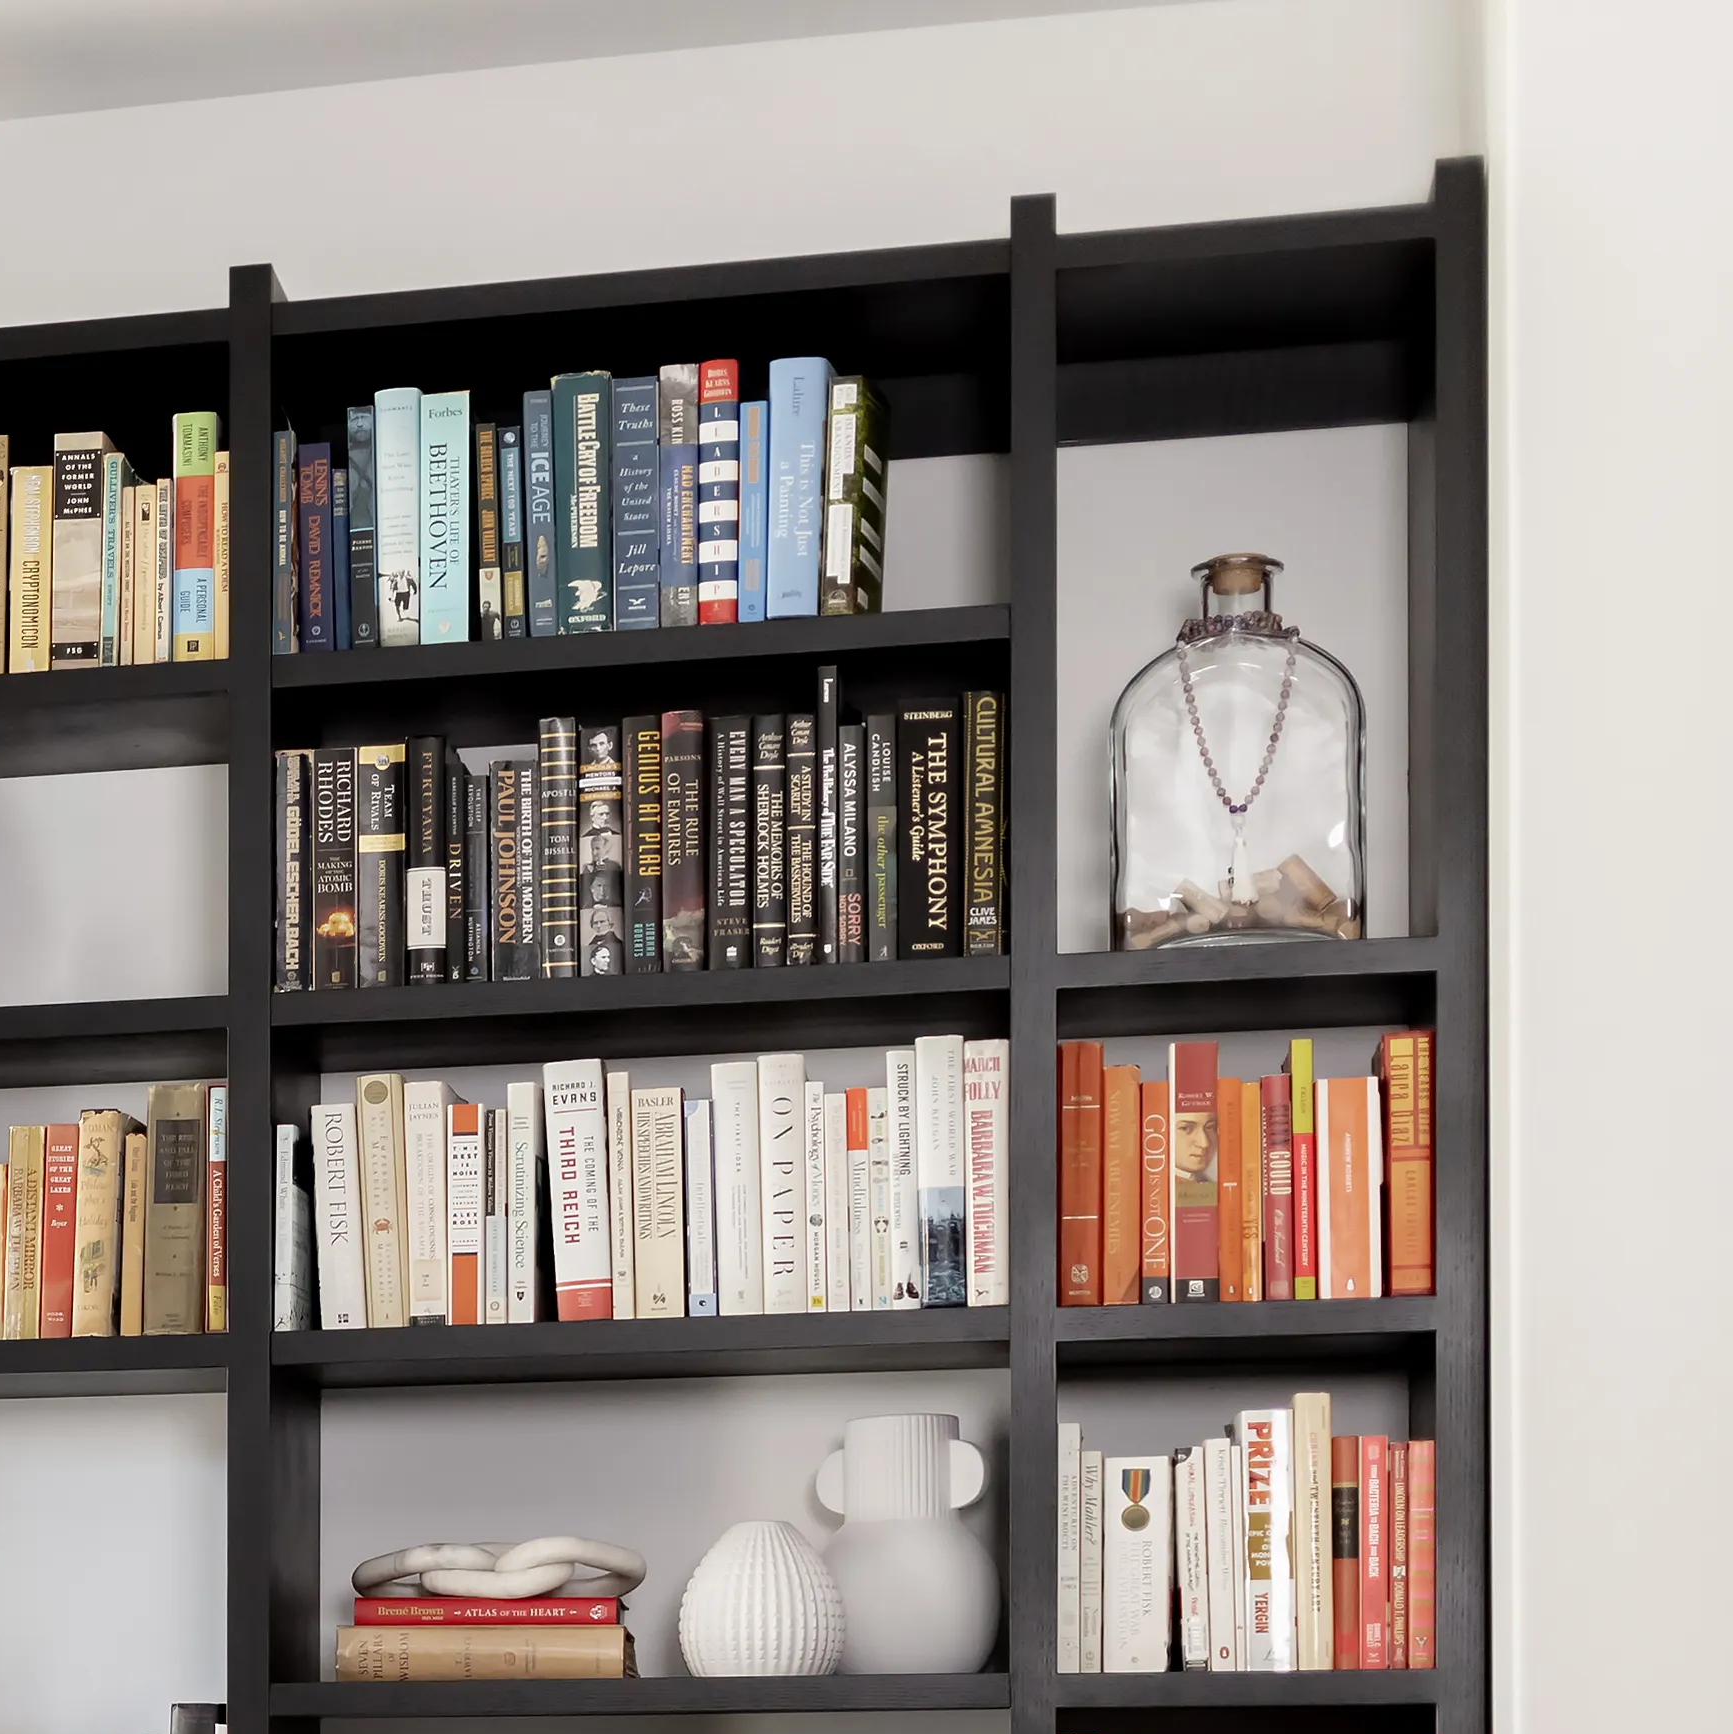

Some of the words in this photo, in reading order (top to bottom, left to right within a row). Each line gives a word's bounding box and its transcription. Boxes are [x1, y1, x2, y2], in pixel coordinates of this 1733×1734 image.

[428, 409, 463, 419] Forbes
[577, 393, 600, 439] BATTLE
[182, 423, 192, 466] TOMMASINI
[198, 427, 208, 461] ANTHONY
[578, 441, 600, 468] CRY
[801, 440, 815, 474] This
[301, 465, 313, 504] TOMB
[314, 459, 327, 506] LENIN'S
[450, 457, 460, 515] THAYER'S
[531, 452, 549, 483] ICE
[578, 469, 597, 483] OF
[681, 465, 693, 486] MAD
[800, 480, 813, 491] is
[108, 461, 117, 524] GULLIVER'S
[532, 486, 550, 523] AGE
[776, 475, 792, 538] Painting
[798, 496, 812, 524] Not
[309, 516, 321, 554] DAVID
[428, 444, 447, 589] BEETHOVEN
[450, 521, 460, 545] LIFE
[578, 485, 601, 548] FREEDOM
[681, 491, 693, 564] ENCHANTMENT
[107, 529, 116, 578] TRAVELS
[450, 550, 460, 565] OF
[796, 528, 812, 556] Just
[22, 561, 39, 649] CRYPTONOMICON
[180, 591, 191, 613] GUIDE
[196, 585, 207, 623] PERSONAL
[309, 560, 321, 619] REMNICK
[903, 712, 952, 720] STEINBERG
[637, 731, 660, 794] GENIUS
[729, 731, 745, 770] EVERY
[927, 732, 947, 784] THE
[975, 697, 996, 797] CULTURAL
[667, 773, 680, 795] OF
[729, 777, 745, 802] MAN
[843, 743, 856, 798] ALYSSA
[317, 762, 334, 843] RHODES
[336, 760, 352, 842] RICHARD
[421, 752, 432, 854] FUKUYAMA
[497, 770, 516, 827] PAUL
[638, 804, 660, 822] AT
[685, 779, 698, 812] THE
[667, 800, 680, 865] EMPIRES
[685, 817, 698, 856] RULE
[843, 801, 856, 857] MILANO
[638, 833, 661, 876] PLAY
[729, 822, 745, 907] SPECULATOR
[927, 792, 947, 930] SYMPHONY
[973, 802, 994, 903] AMNESIA
[421, 878, 432, 936] TRUST
[493, 828, 516, 944] JOHNSON
[848, 893, 861, 945] SORRY
[968, 917, 997, 925] JAMES
[969, 907, 995, 916] CLIVE
[896, 1064, 908, 1103] STRUCK
[771, 1097, 793, 1142] ON
[898, 1106, 908, 1119] BY
[324, 1113, 346, 1194] ROBERT
[559, 1126, 576, 1181] THIRD
[654, 1112, 676, 1179] ABRAHAM
[898, 1122, 911, 1176] LIGHTNING
[1143, 1114, 1166, 1172] GOD
[212, 1180, 222, 1208] Child's
[512, 1142, 528, 1218] Scrutinizing
[1149, 1174, 1161, 1185] IS
[212, 1209, 222, 1238] Garden
[329, 1202, 348, 1246] FISK
[563, 1191, 580, 1245] REICH
[655, 1181, 678, 1239] LINCOLN
[772, 1160, 795, 1278] PAPER
[1149, 1188, 1162, 1216] NOT
[212, 1240, 222, 1249] of
[212, 1250, 221, 1277] Verses
[514, 1220, 528, 1269] Science
[1144, 1216, 1166, 1270] ONE
[1084, 1465, 1098, 1490] Why
[1247, 1421, 1273, 1506] PRIZE
[1085, 1493, 1097, 1545] Mahler?
[377, 1607, 409, 1616] Brené
[410, 1607, 444, 1616] Brown
[465, 1608, 497, 1616] ATLAS
[530, 1608, 565, 1616] HEART
[1254, 1592, 1269, 1634] YERGIN
